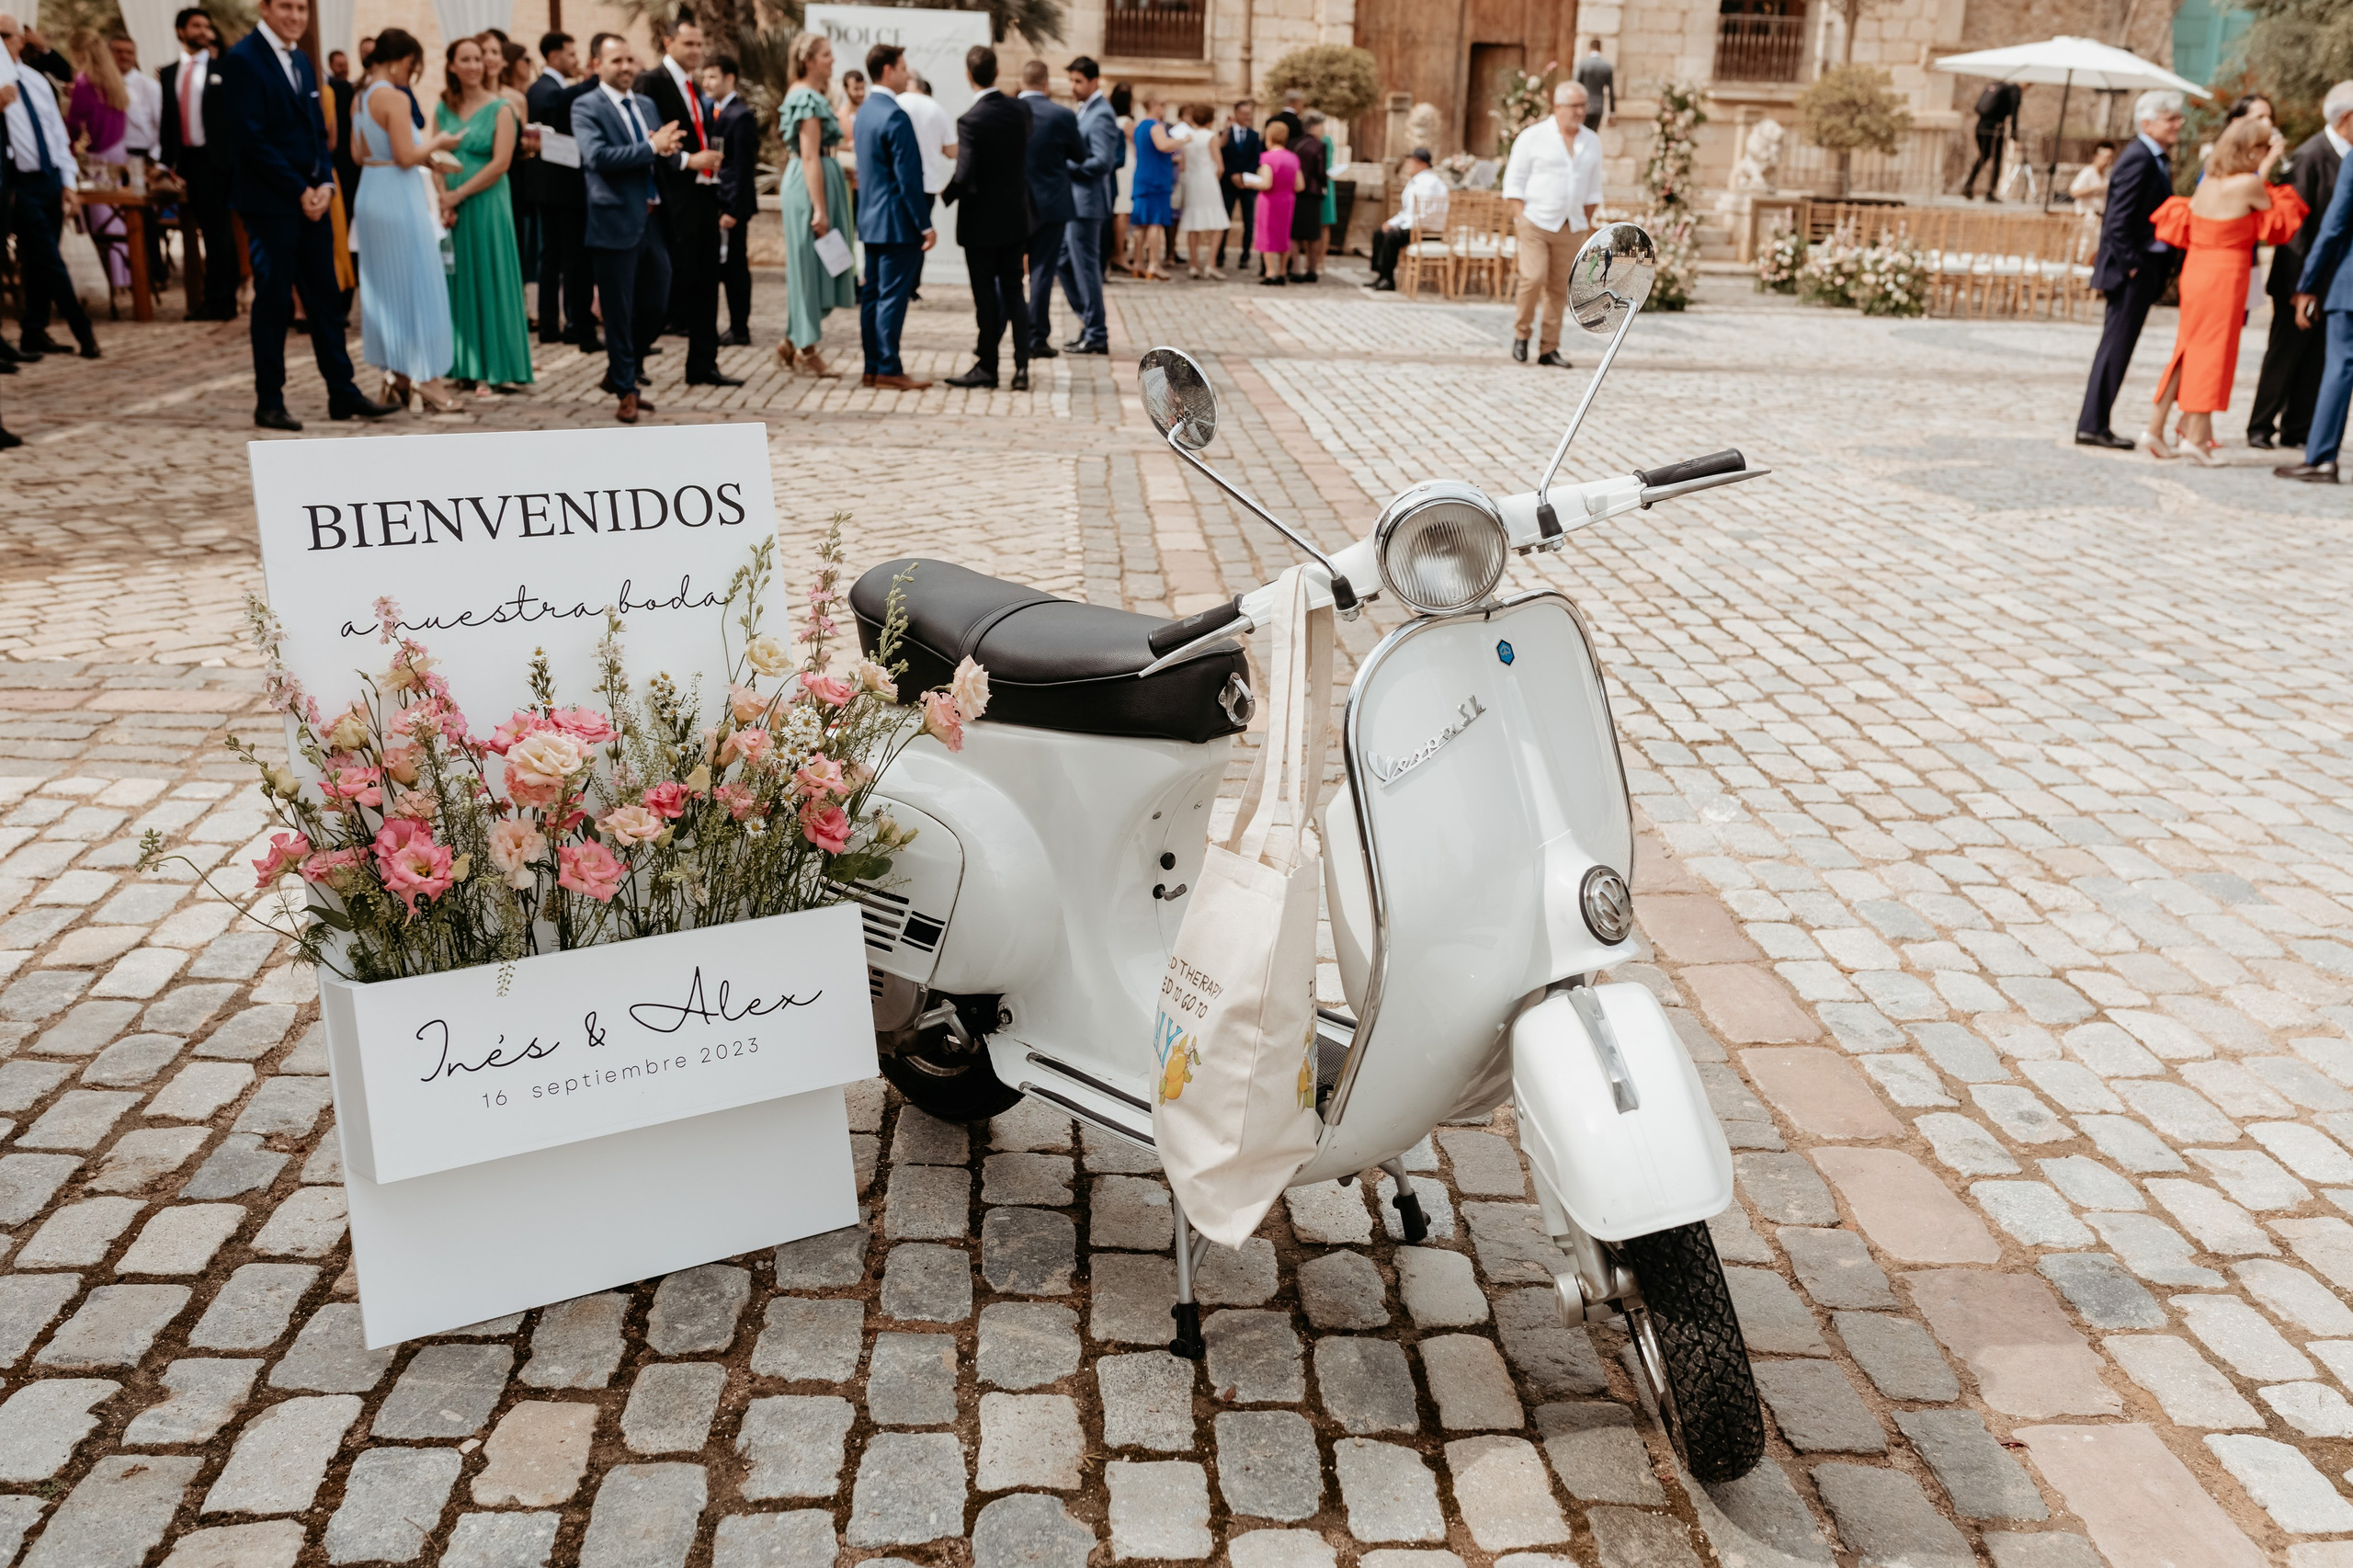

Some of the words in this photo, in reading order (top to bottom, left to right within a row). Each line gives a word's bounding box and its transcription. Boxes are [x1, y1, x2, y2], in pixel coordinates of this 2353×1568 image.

[827, 25, 905, 47] DOLCE
[302, 483, 746, 551] BIENVENIDOS
[341, 621, 378, 637] a
[389, 585, 604, 637] nuestra
[620, 574, 733, 614] boda
[1367, 722, 1460, 783] Vespa
[1172, 986, 1183, 1003] TO
[1180, 994, 1197, 1012] GO
[1195, 1002, 1209, 1019] TO
[1180, 959, 1224, 1000] THERAPY
[416, 1019, 560, 1082] Inés
[585, 1011, 607, 1047] &
[630, 966, 823, 1032] Alex
[483, 1089, 508, 1108] 16
[532, 1055, 688, 1096] septiembre
[700, 1037, 759, 1063] 2023
